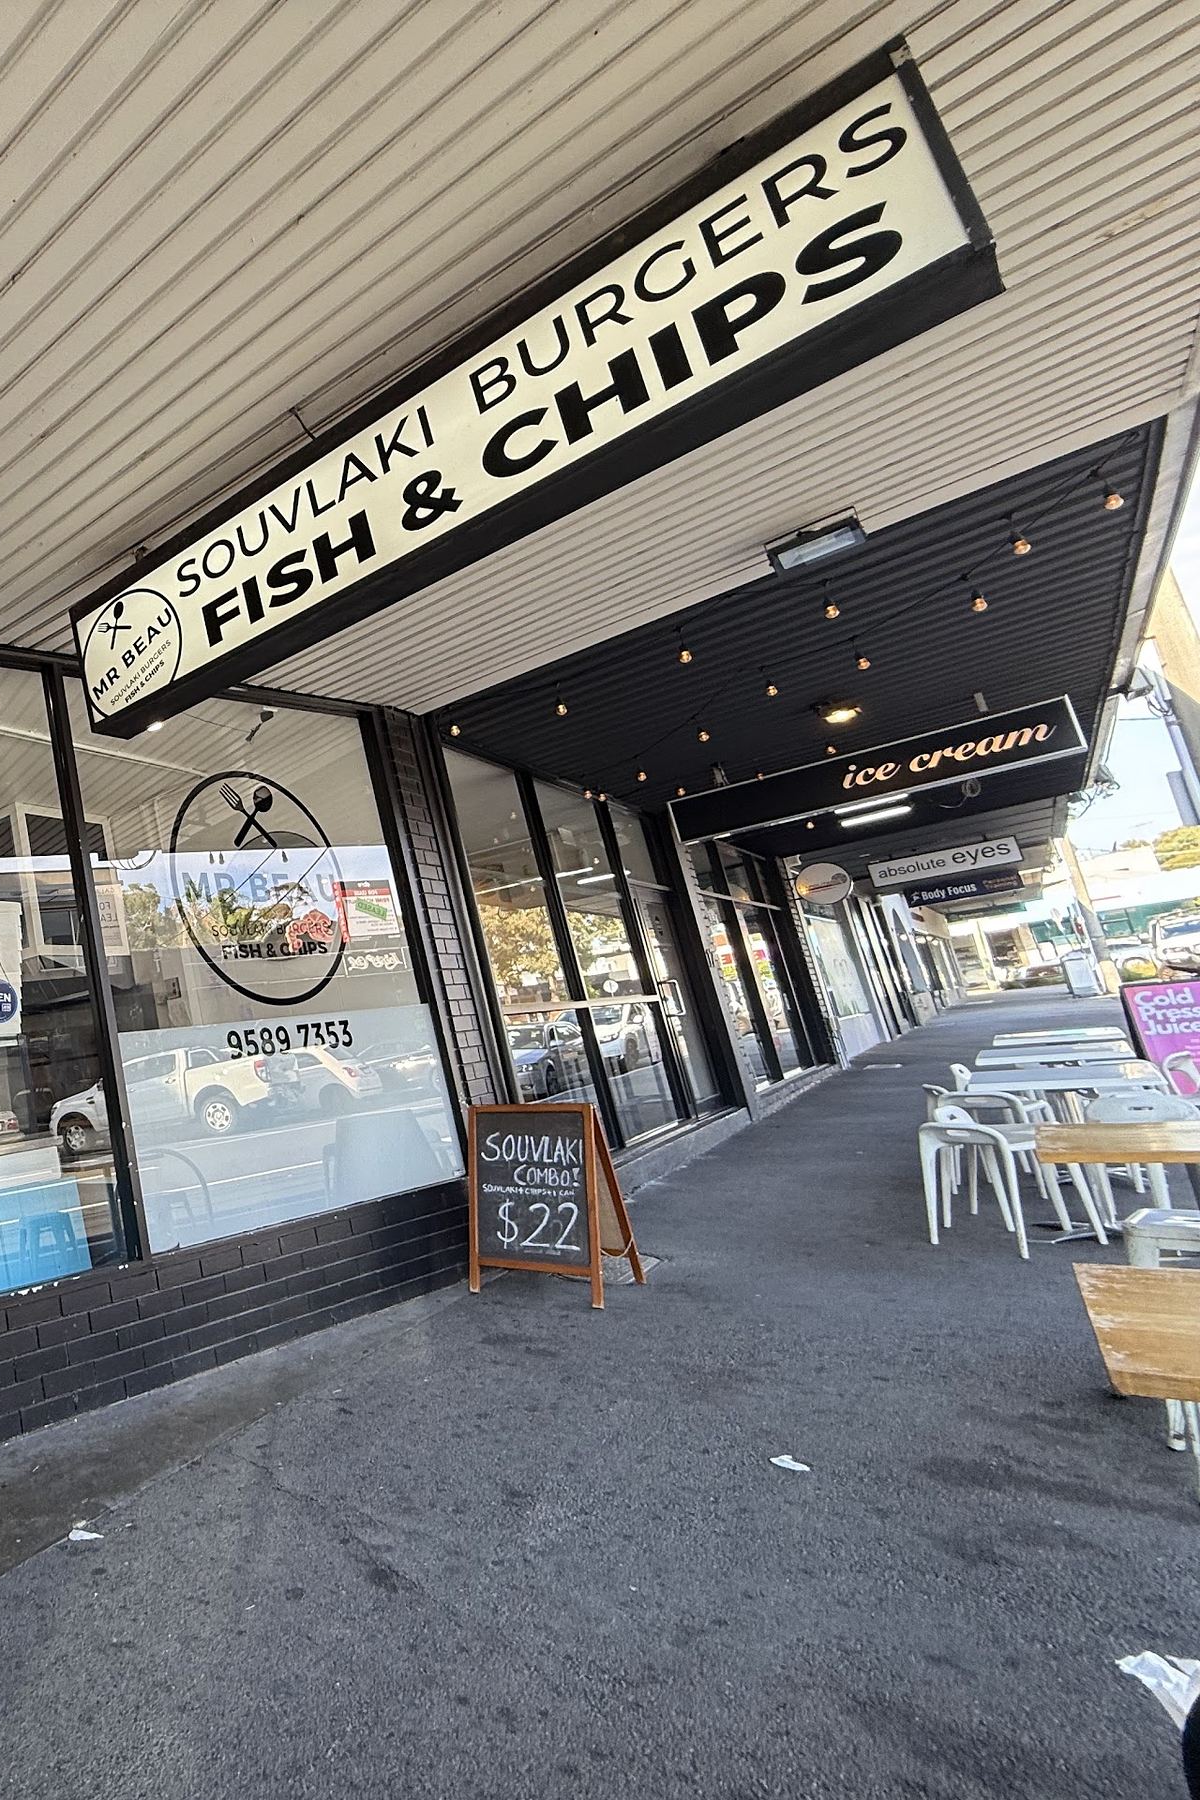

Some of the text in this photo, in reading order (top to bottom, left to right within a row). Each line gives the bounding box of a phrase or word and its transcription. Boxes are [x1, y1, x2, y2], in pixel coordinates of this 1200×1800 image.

[176, 101, 907, 597] SOUVLAKI BURGERS
[200, 200, 902, 648] FISH & CHIPS
[92, 608, 172, 701] MR BEAU
[110, 640, 171, 706] SOUVLAKI BURGERS
[124, 686, 140, 703] FISH
[144, 660, 165, 682] CHIPS
[842, 723, 1056, 790] ice cream
[878, 843, 1011, 878] absolute eyes
[921, 883, 977, 901] Body Focus
[222, 944, 262, 960] FISH
[266, 942, 278, 957] &
[1134, 987, 1194, 1006] Cold
[227, 1019, 353, 1060] 9589 7353
[481, 1132, 583, 1166] SOUVLAKI
[514, 1164, 581, 1187] COMBO!
[496, 1198, 581, 1250] $22
